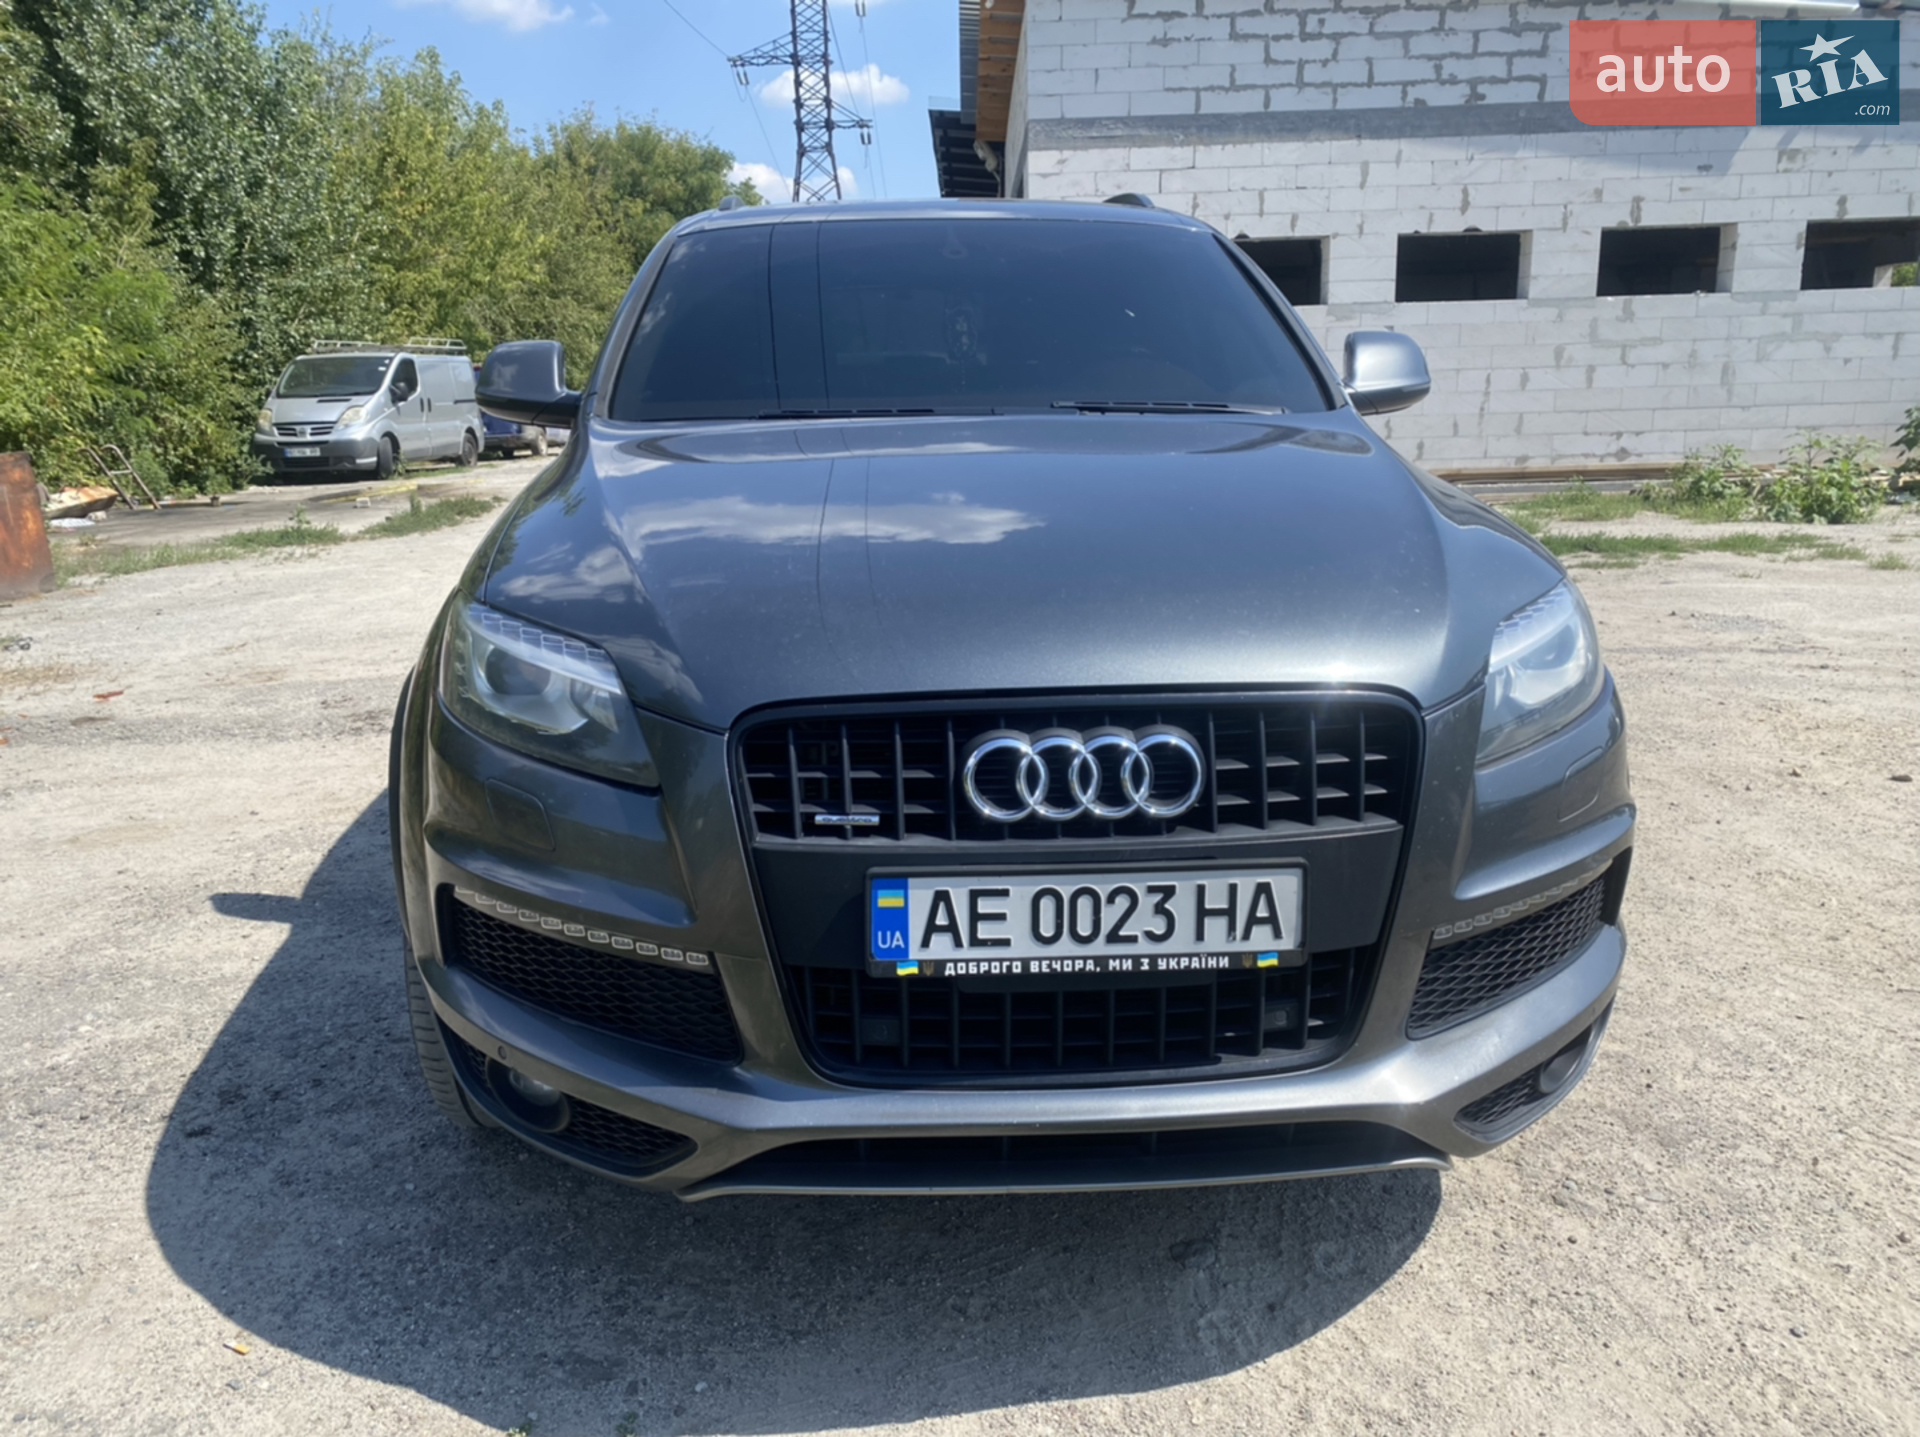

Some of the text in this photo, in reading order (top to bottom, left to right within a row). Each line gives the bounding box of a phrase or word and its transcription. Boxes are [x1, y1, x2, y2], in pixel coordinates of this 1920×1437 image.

[920, 880, 1284, 949] AE 0023 HA
[877, 931, 905, 949] UA
[944, 961, 1023, 977] ДОБРОГО
[1030, 958, 1102, 974] ВЕЧОРА,
[1109, 957, 1133, 971] МИ
[1158, 953, 1230, 971] УКРАЇНИ
